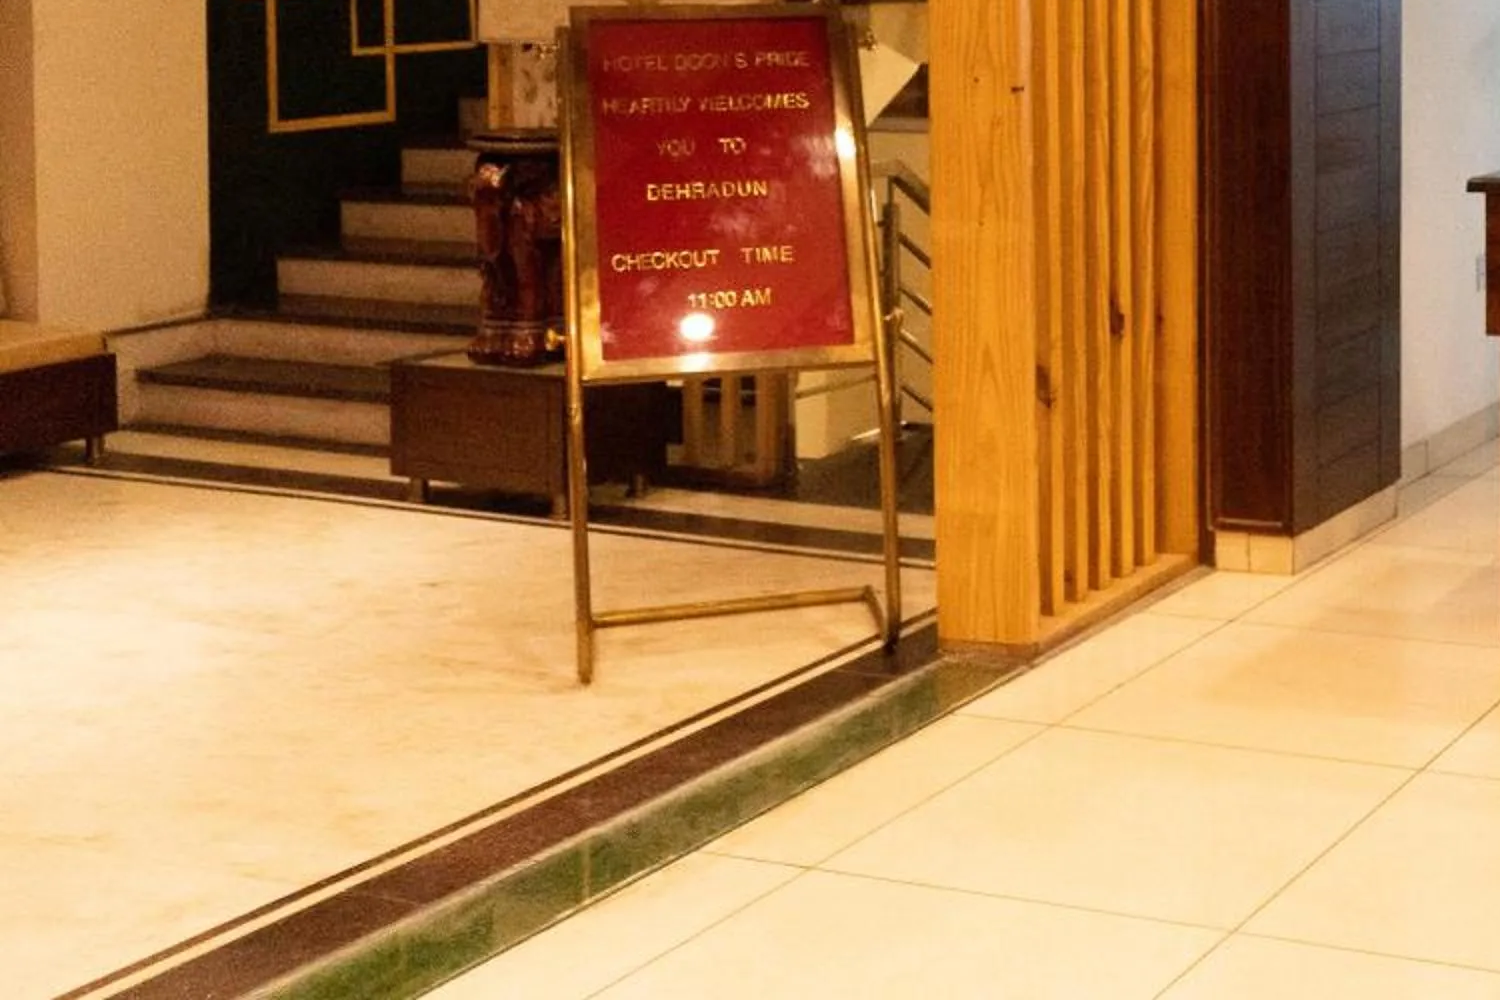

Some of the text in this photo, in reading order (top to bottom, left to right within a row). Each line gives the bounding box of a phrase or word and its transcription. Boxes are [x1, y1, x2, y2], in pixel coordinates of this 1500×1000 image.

[602, 55, 667, 71] HOTEL
[657, 137, 747, 156] YOU TO
[647, 180, 767, 201] DEHRADUN
[611, 246, 793, 272] CHECKOUT TIME
[740, 287, 772, 307] AM
